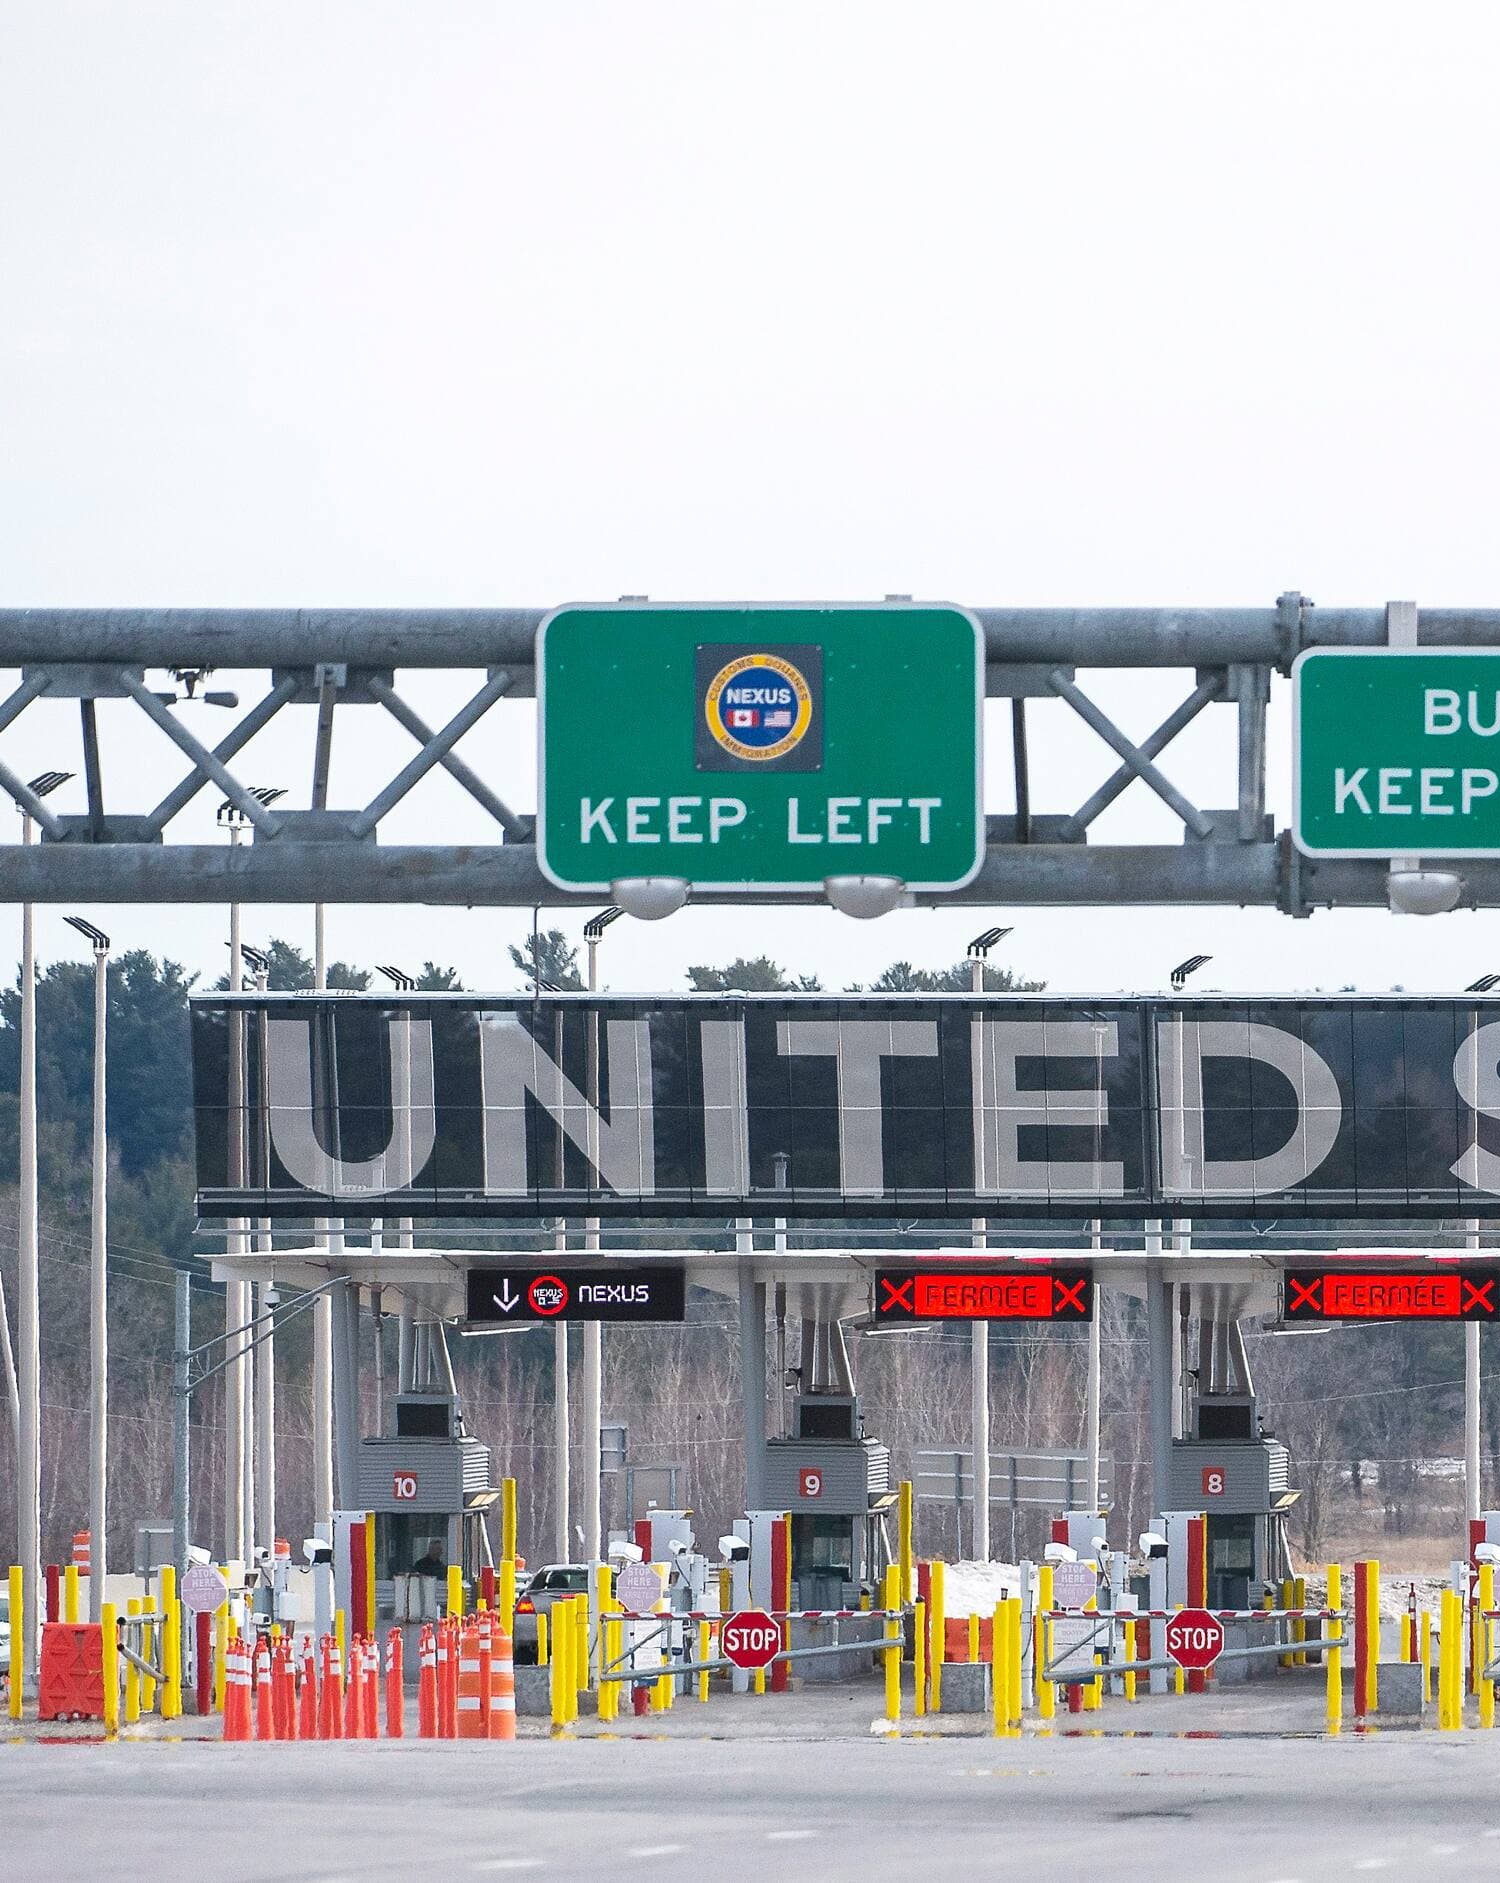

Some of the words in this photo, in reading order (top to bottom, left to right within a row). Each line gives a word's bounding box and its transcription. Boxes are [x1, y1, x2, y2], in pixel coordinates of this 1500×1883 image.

[726, 688, 791, 704] NEXUS
[1335, 768, 1499, 814] KEEP
[580, 797, 747, 844] KEEP
[788, 797, 942, 844] LEFT
[266, 1018, 1343, 1200] UNITED
[578, 1284, 650, 1303] NEXUS
[926, 1279, 1038, 1308] FERMÉE
[1335, 1279, 1446, 1308] FERMÉE
[394, 1478, 417, 1498] 10
[805, 1475, 820, 1495] 9
[1208, 1474, 1223, 1494] 8
[192, 1568, 216, 1578] STOP
[628, 1567, 651, 1576] STOP
[1061, 1564, 1085, 1574] STOP
[1061, 1574, 1085, 1584] HERE
[191, 1579, 216, 1588] HERE
[628, 1577, 651, 1586] HERE
[726, 1628, 777, 1651] STOP
[1169, 1627, 1220, 1650] STOP
